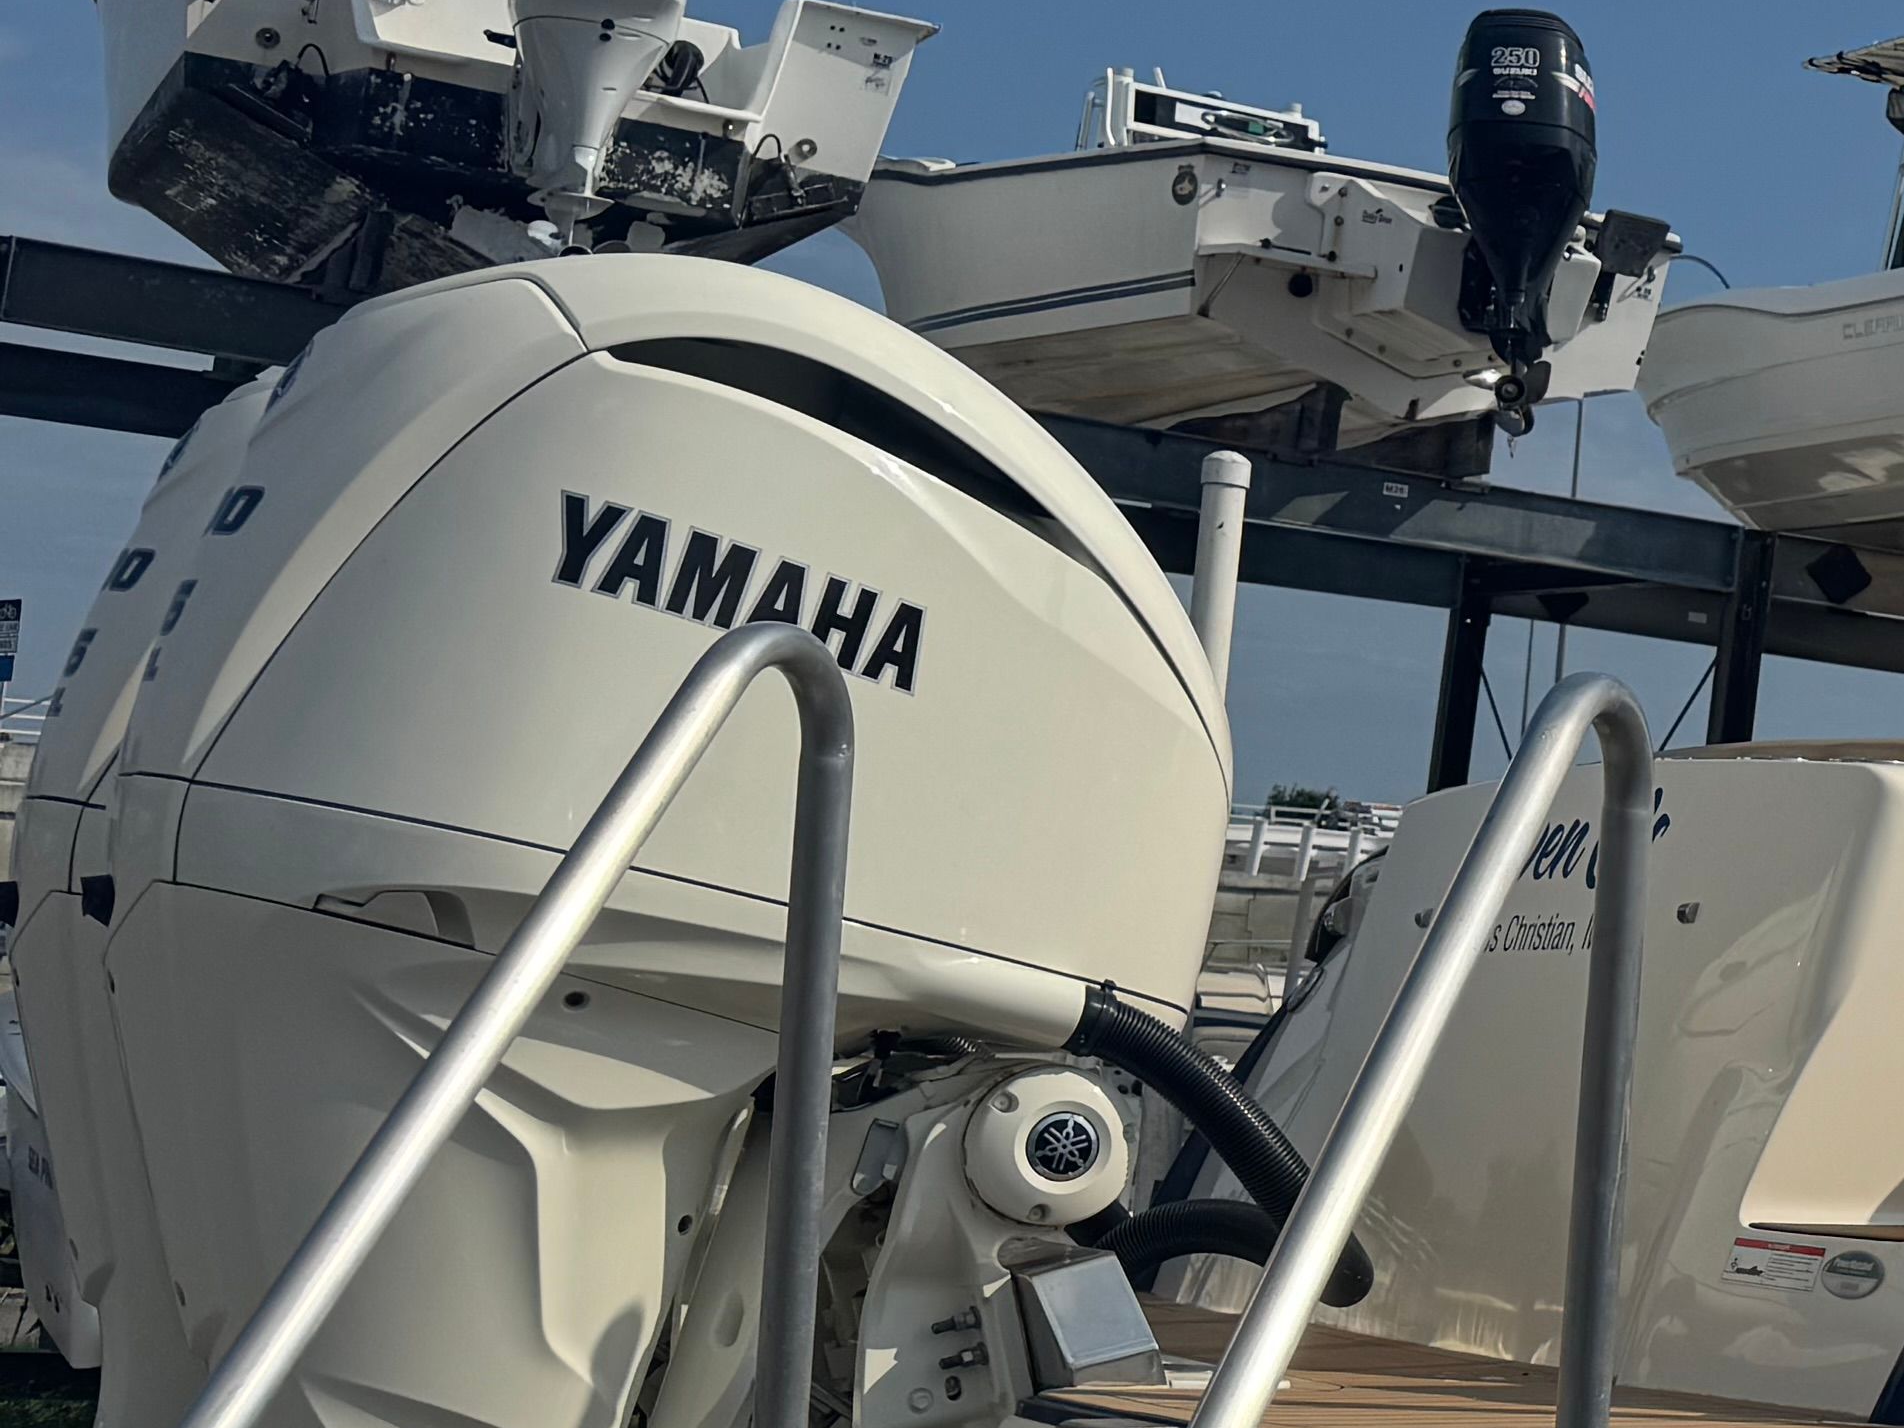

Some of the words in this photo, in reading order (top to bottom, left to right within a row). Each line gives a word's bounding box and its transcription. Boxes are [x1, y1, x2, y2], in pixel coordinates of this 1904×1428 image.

[1490, 46, 1541, 68] 250
[551, 489, 928, 697] YAMAHA
[1503, 913, 1576, 956] Christian,
